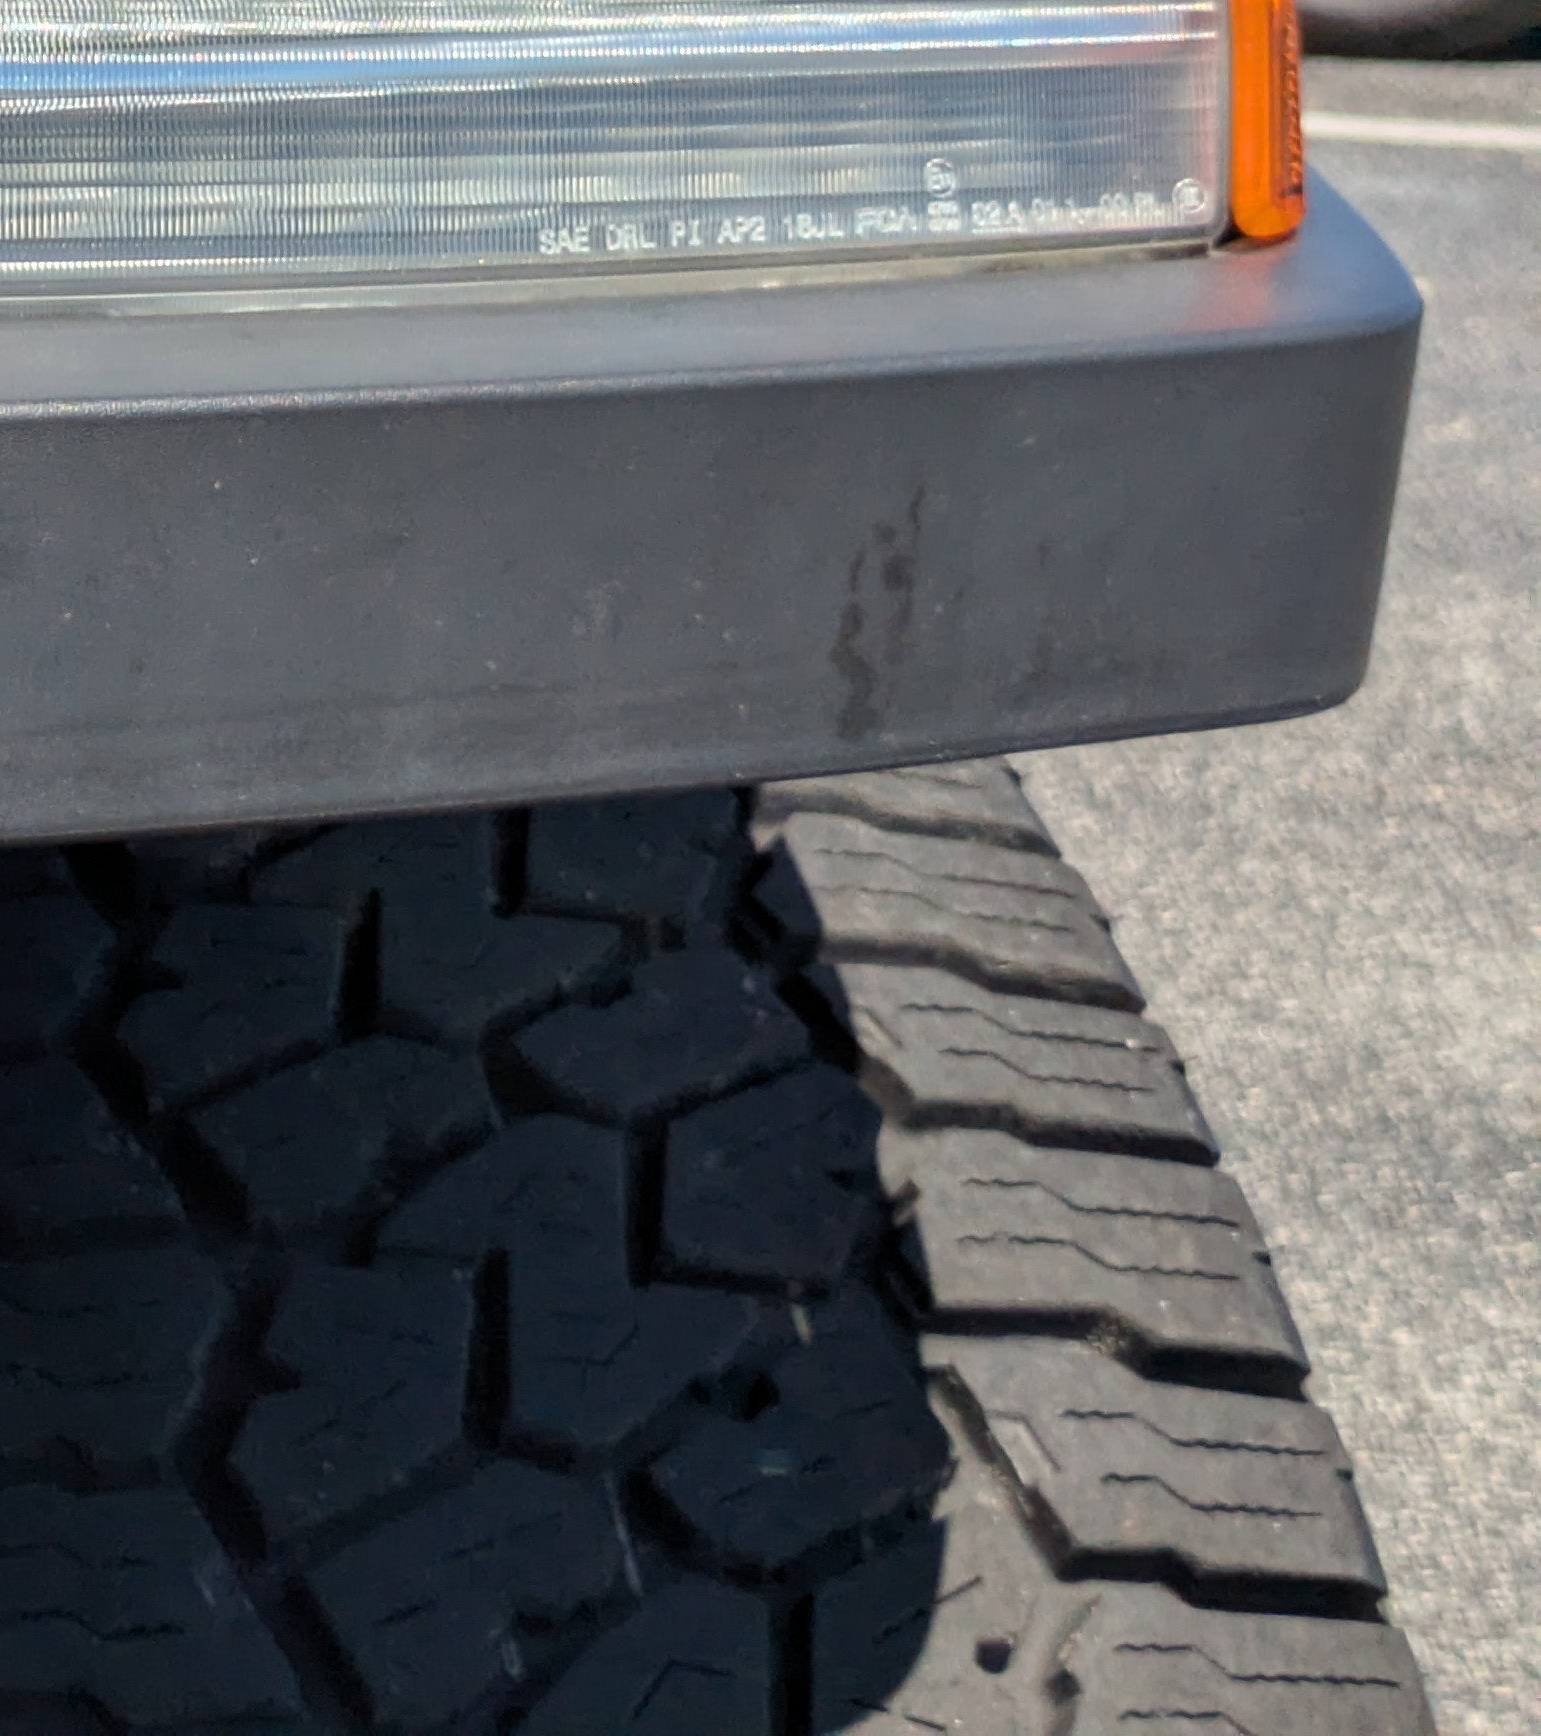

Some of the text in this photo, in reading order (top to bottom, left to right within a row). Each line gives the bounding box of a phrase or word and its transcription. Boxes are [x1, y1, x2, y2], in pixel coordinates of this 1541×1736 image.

[538, 224, 591, 255] SAE
[605, 222, 656, 251] DRL
[716, 214, 767, 243] AP2
